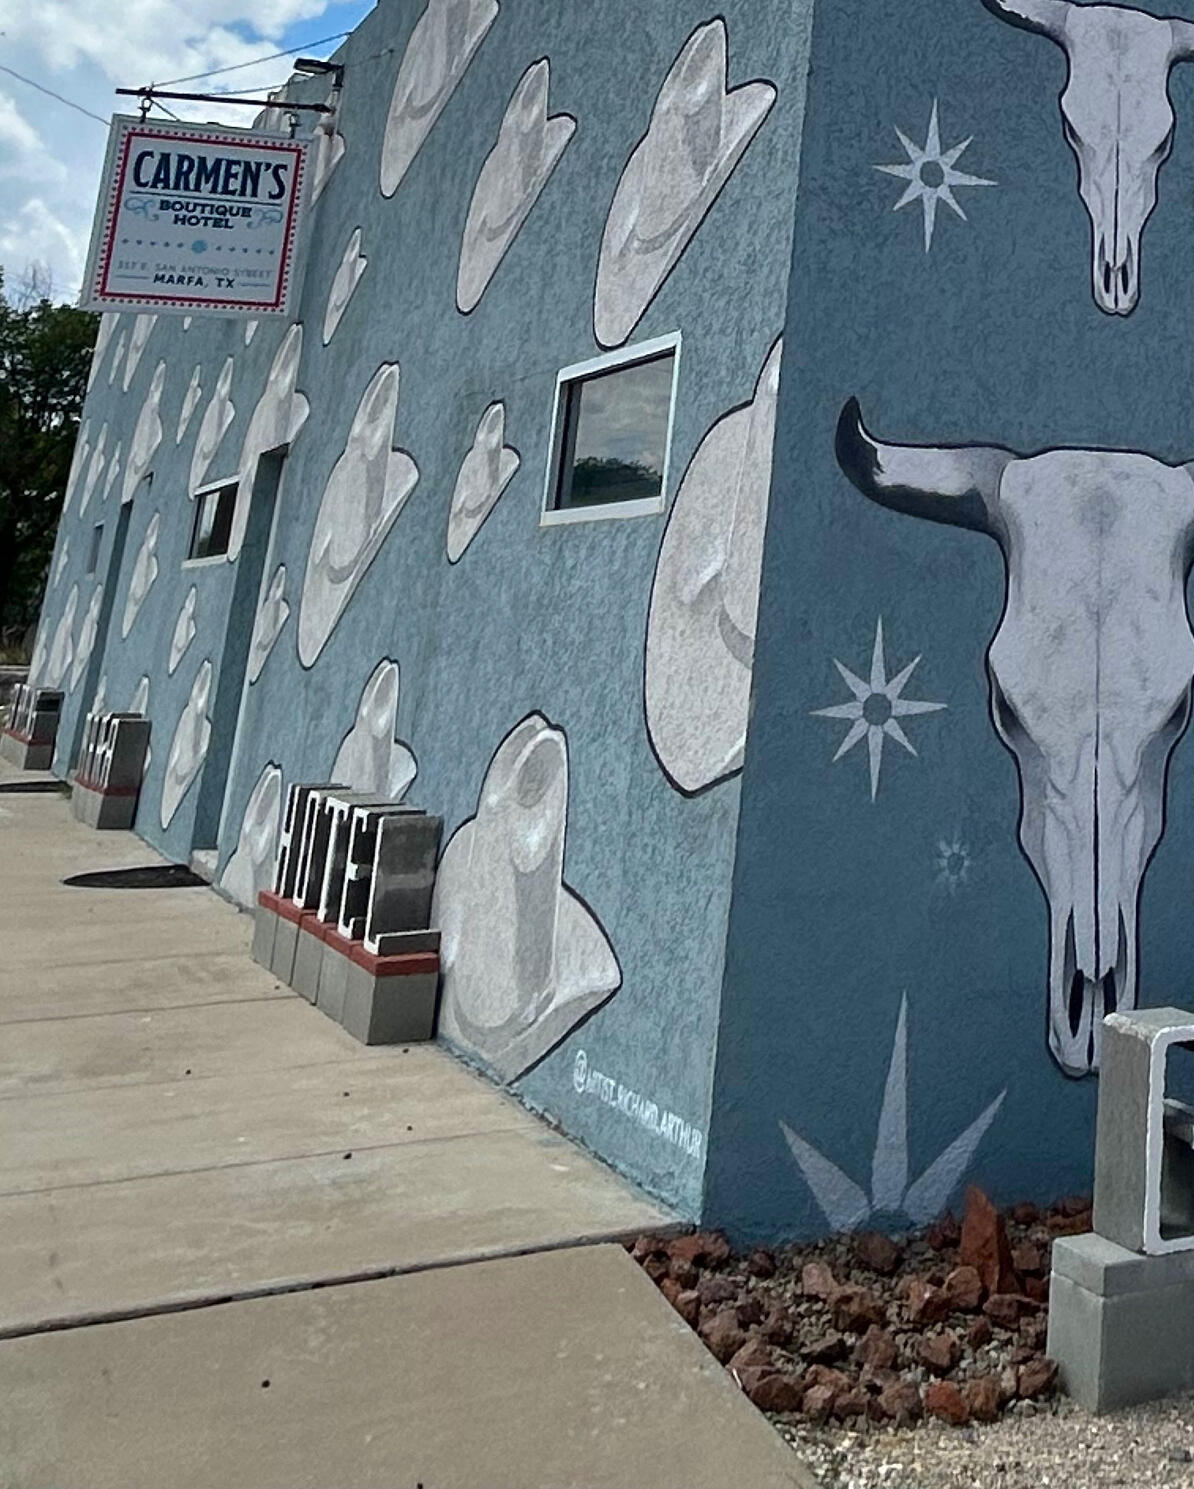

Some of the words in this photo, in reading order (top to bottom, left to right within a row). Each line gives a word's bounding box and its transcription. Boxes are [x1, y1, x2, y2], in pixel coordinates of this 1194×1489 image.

[133, 150, 288, 200] CARMEN'S
[159, 199, 253, 218] BOUTIQUE
[173, 214, 234, 229] HOTEL
[155, 262, 176, 273] SAN
[180, 265, 230, 276] ANTONIO
[234, 268, 273, 278] STREET
[153, 273, 208, 288] MARFA,
[215, 277, 236, 289] TX
[273, 782, 392, 956] HOTEL
